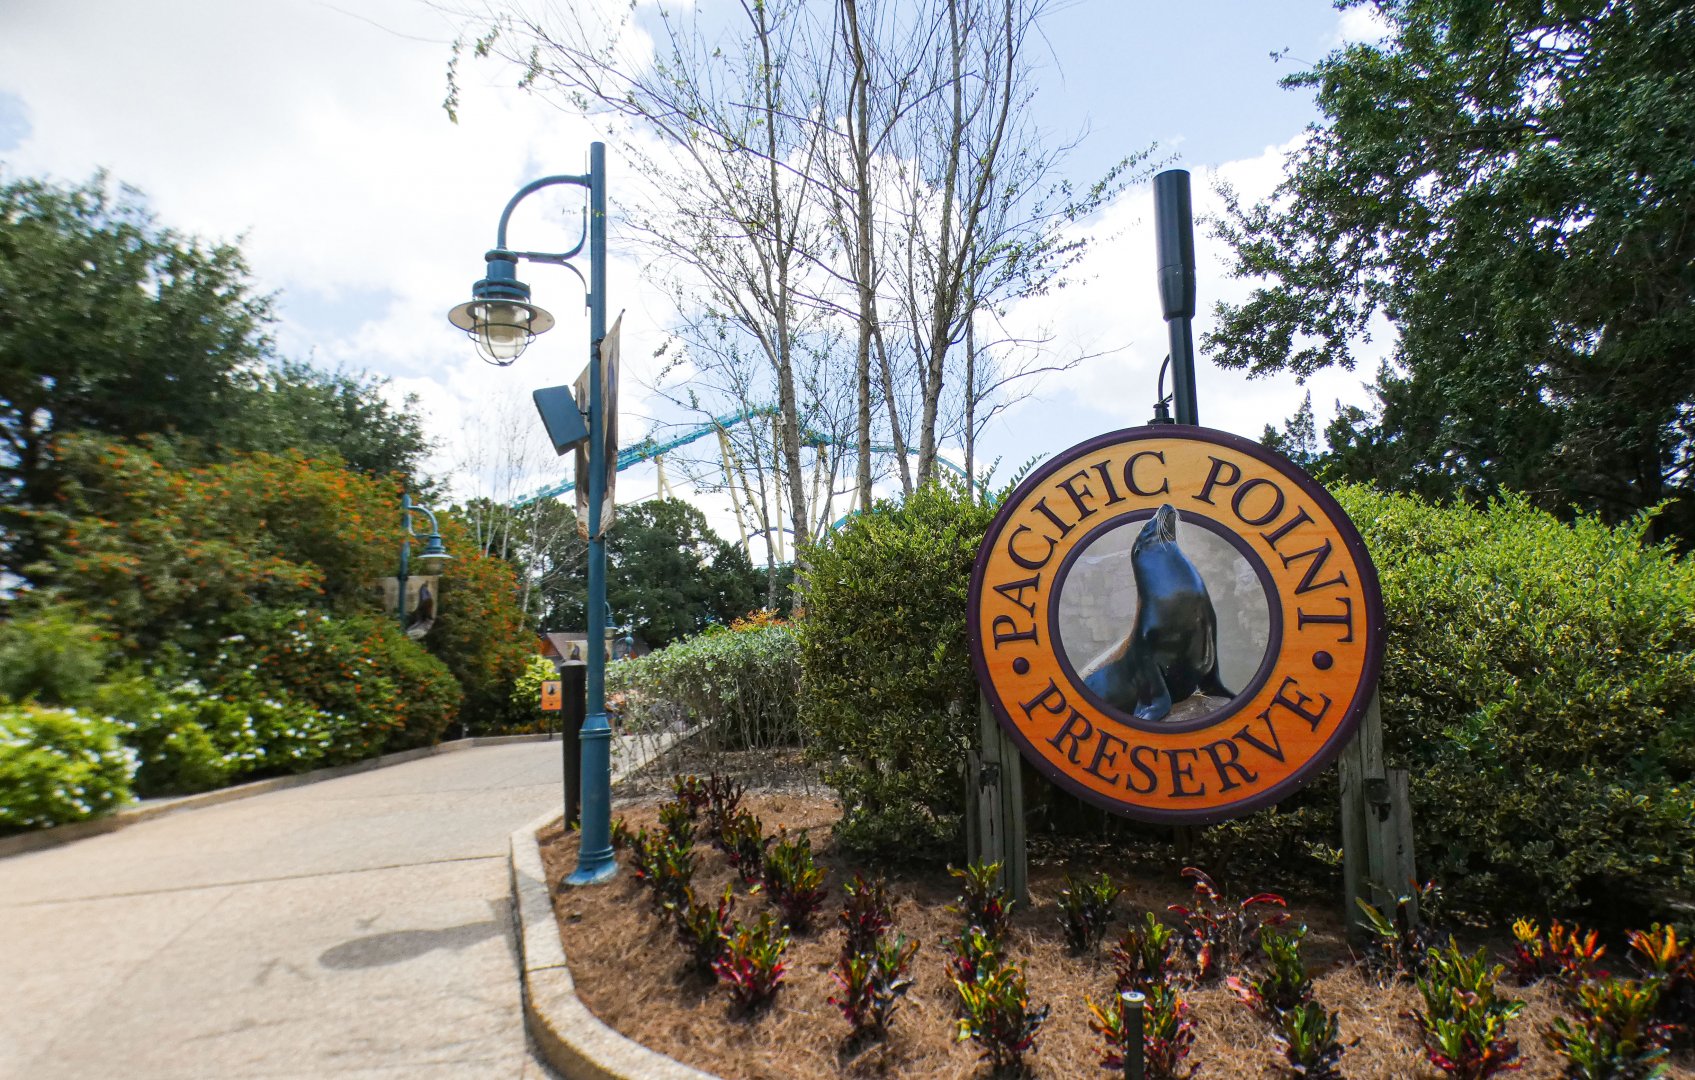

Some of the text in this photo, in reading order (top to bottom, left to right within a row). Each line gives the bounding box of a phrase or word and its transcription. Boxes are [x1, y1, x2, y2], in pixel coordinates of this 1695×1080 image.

[992, 451, 1353, 650] PACIFIC POINT
[1018, 675, 1332, 798] PRESERVE
